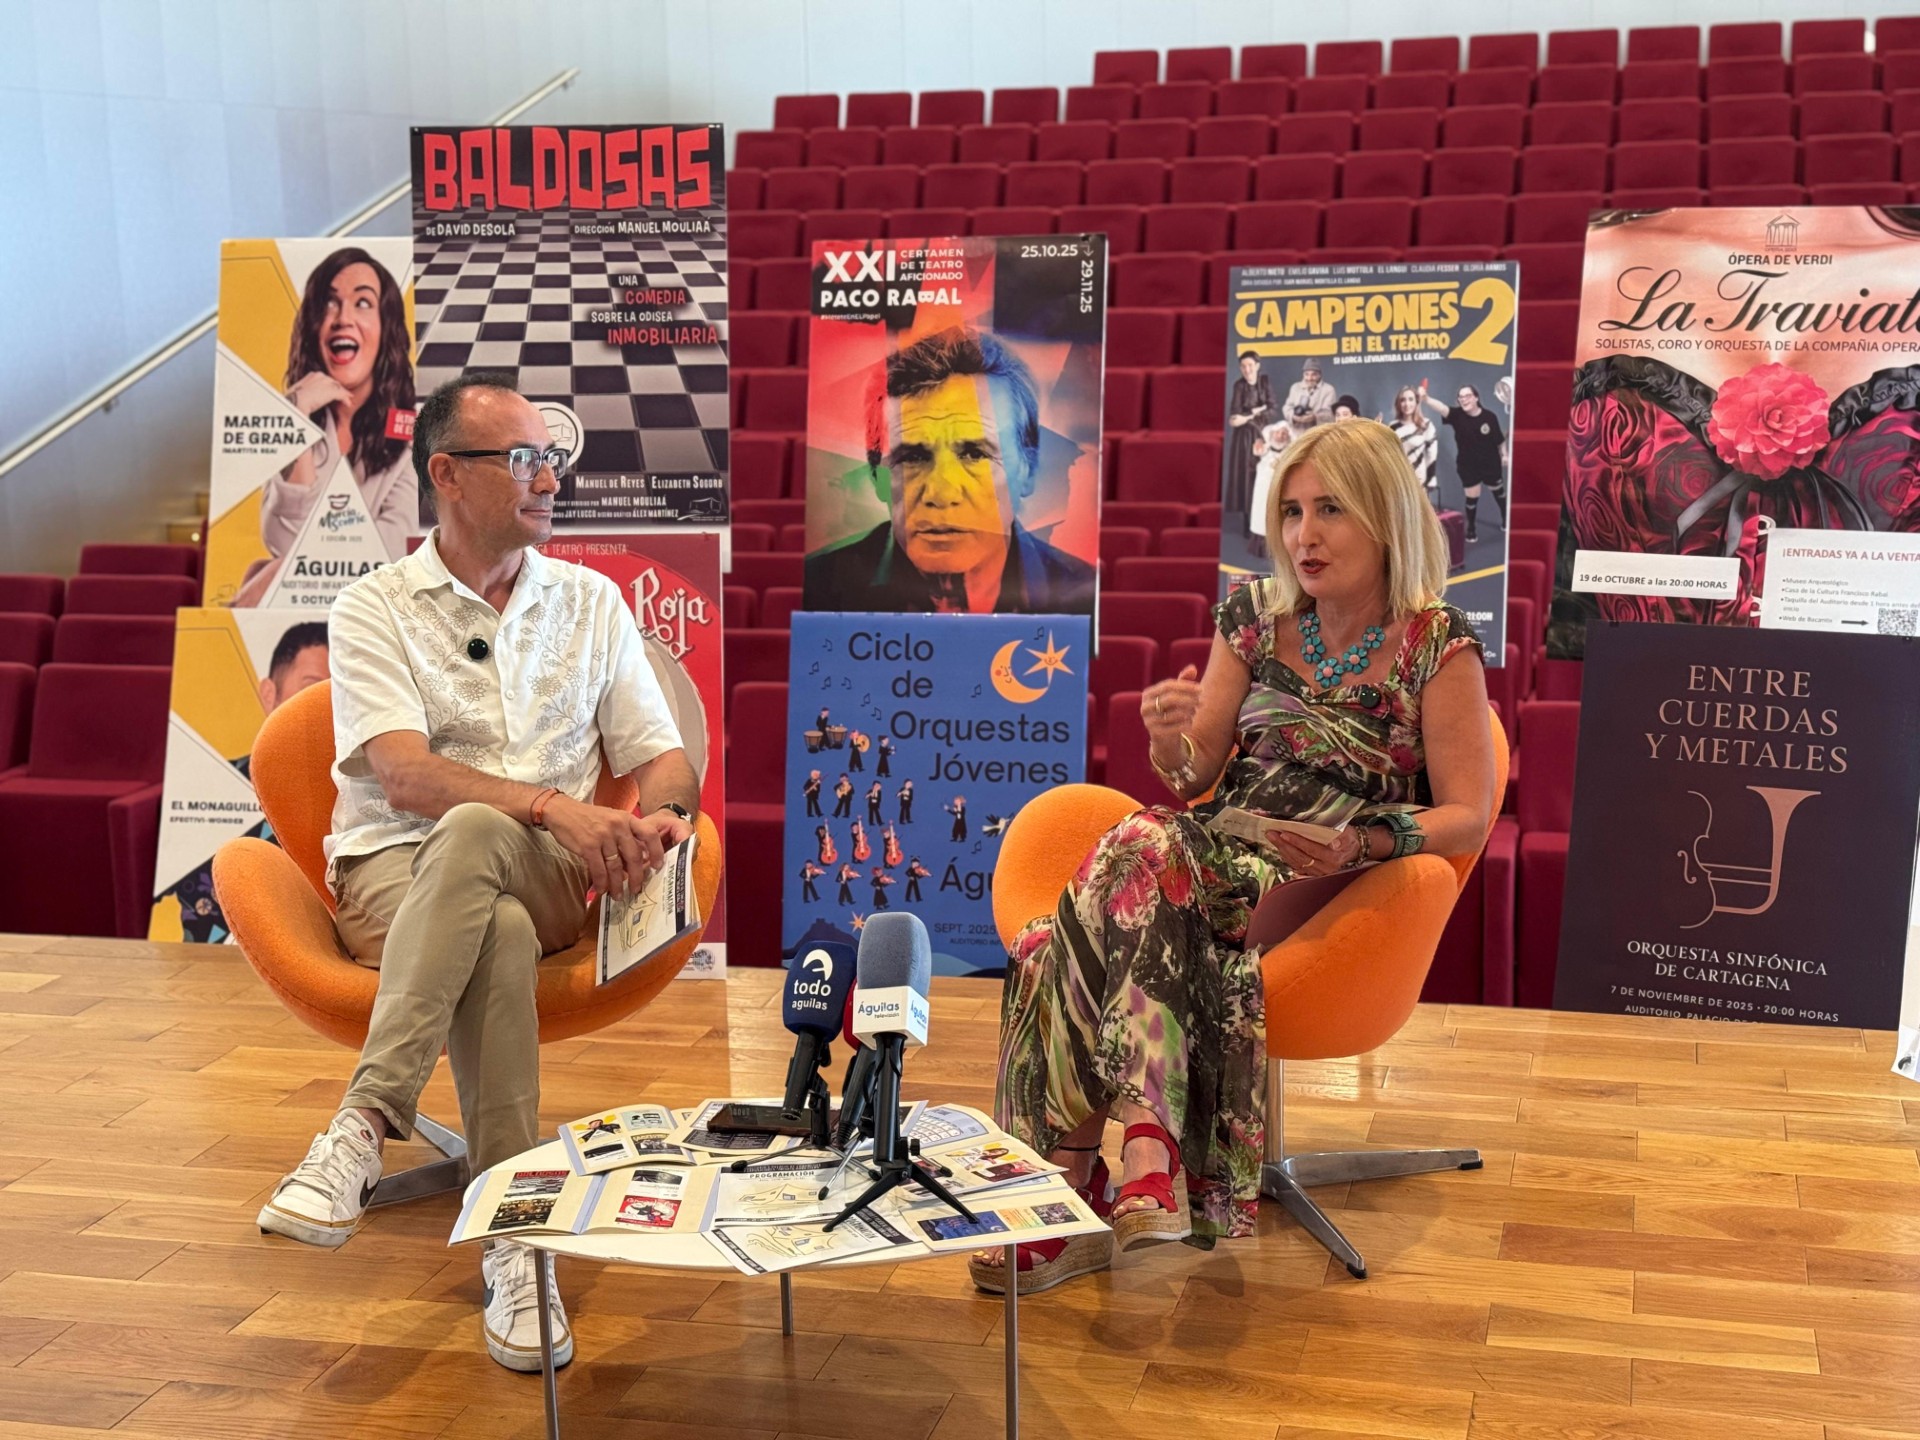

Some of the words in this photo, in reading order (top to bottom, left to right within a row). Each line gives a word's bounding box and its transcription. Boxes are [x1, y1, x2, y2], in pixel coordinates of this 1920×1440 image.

[423, 126, 711, 211] BALDOSAS
[426, 227, 436, 237] DE
[437, 223, 471, 237] DAVID
[472, 223, 516, 236] DESOLA
[574, 221, 616, 234] DIRECCIÓN
[618, 222, 661, 234] MANUEL
[662, 217, 711, 233] MOULIAÁ
[900, 248, 964, 258] CERTAMEN
[1021, 244, 1079, 258] 25.10.25
[1728, 252, 1771, 265] ÓPERA
[1774, 254, 1790, 265] DE
[1794, 254, 1833, 265] VERDI
[822, 250, 897, 283] XXI
[900, 261, 916, 270] DE
[919, 260, 964, 269] TEATRO
[618, 275, 639, 286] UNA
[900, 272, 963, 281] AFICIONADO
[1080, 260, 1094, 313] 29.11.25
[625, 289, 686, 305] COMEDIA
[820, 289, 880, 308] PACO
[887, 287, 962, 306] RABAL
[1598, 266, 1697, 333] La
[591, 311, 623, 323] SOBRE
[624, 311, 637, 323] LA
[639, 311, 673, 322] ODISEA
[1235, 292, 1460, 338] CAMPEONES
[1448, 278, 1515, 365] 2
[607, 325, 718, 346] INMOBILIARIA
[1341, 335, 1362, 353] EN
[1367, 335, 1384, 352] EL
[1388, 331, 1451, 351] TEATRO
[1595, 338, 1655, 351] SOLISTAS,
[1658, 339, 1692, 350] CORO
[1695, 339, 1703, 349] Y
[1704, 339, 1772, 352] ORQUESTA
[1775, 340, 1791, 350] DE
[1794, 341, 1809, 350] LA
[1403, 353, 1412, 361] LA
[224, 416, 295, 428] MARTITA
[224, 432, 246, 444] DE
[249, 429, 307, 444] GRANÁ
[601, 496, 631, 506] MANUEL
[552, 543, 583, 556] TEATRO
[586, 543, 628, 556] PRESENTA
[1845, 550, 1858, 559] YA
[1860, 551, 1868, 560] A
[1871, 551, 1884, 561] LA
[1887, 552, 1920, 562] VENTA
[1579, 574, 1590, 582] 19
[1591, 574, 1603, 583] de
[1604, 575, 1646, 585] OCTUBRE
[1655, 578, 1667, 586] las
[1669, 578, 1694, 587] 20:00
[1696, 580, 1728, 589] HORAS
[291, 595, 298, 604] 5
[629, 567, 711, 664] Roja
[848, 632, 934, 662] Ciclo
[891, 670, 933, 698] de
[1688, 664, 1812, 699] ENTRE
[1658, 698, 1839, 737] CUERDAS
[890, 710, 1070, 747] Orquestas
[1645, 732, 1665, 760] Y
[1677, 736, 1849, 775] METALES
[929, 752, 1069, 784] Jóvenes
[171, 800, 184, 810] EL
[934, 922, 965, 934] SEPT.
[968, 924, 997, 935] 2025
[950, 937, 988, 945] AUDITORIO
[1627, 939, 1721, 965] ORQUESTA
[1726, 951, 1828, 977] SINFÓNICA
[1655, 961, 1679, 978] DE
[1682, 964, 1791, 992] CARTAGENA
[793, 979, 832, 997] todo
[791, 998, 828, 1011] aguilas
[858, 1001, 900, 1016] Águilas
[1611, 985, 1617, 994] 7
[1620, 986, 1634, 996] DE
[1638, 989, 1704, 1005] NOVIEMBRE
[1708, 998, 1723, 1008] DE
[1726, 1000, 1754, 1011] 2025
[1763, 1004, 1795, 1017] 20:00
[1799, 1009, 1839, 1022] HORAS
[1624, 1004, 1681, 1019] AUDITORIO
